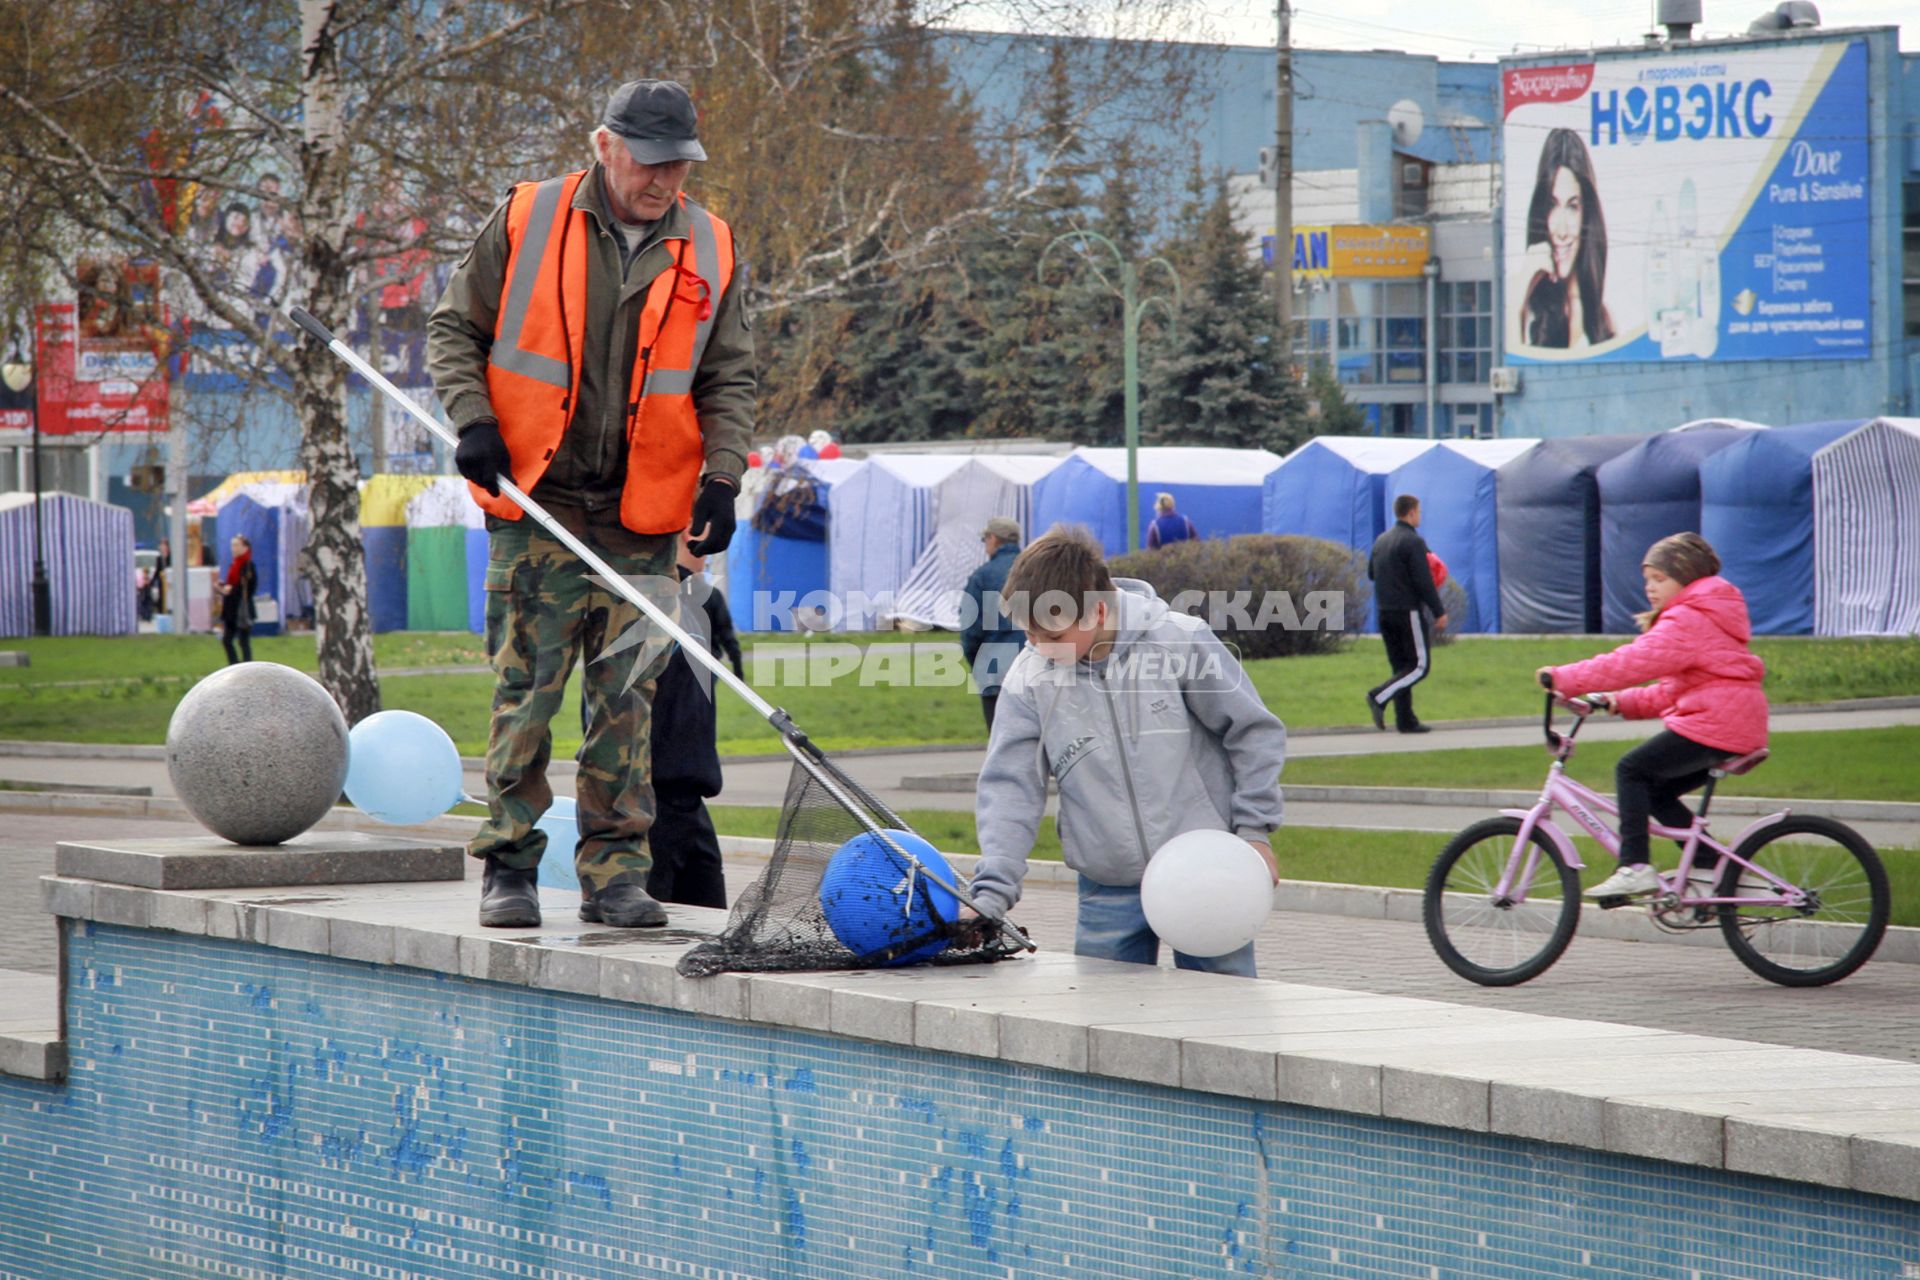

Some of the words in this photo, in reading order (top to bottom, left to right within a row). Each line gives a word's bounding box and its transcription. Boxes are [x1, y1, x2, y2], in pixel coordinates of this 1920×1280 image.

[1509, 68, 1588, 97] Эксклюзивно
[1590, 78, 1773, 146] НОВЭКС
[1791, 140, 1842, 177] Dove
[1769, 183, 1797, 203] Pure
[1800, 182, 1809, 202] &
[1811, 181, 1863, 202] Sensitive
